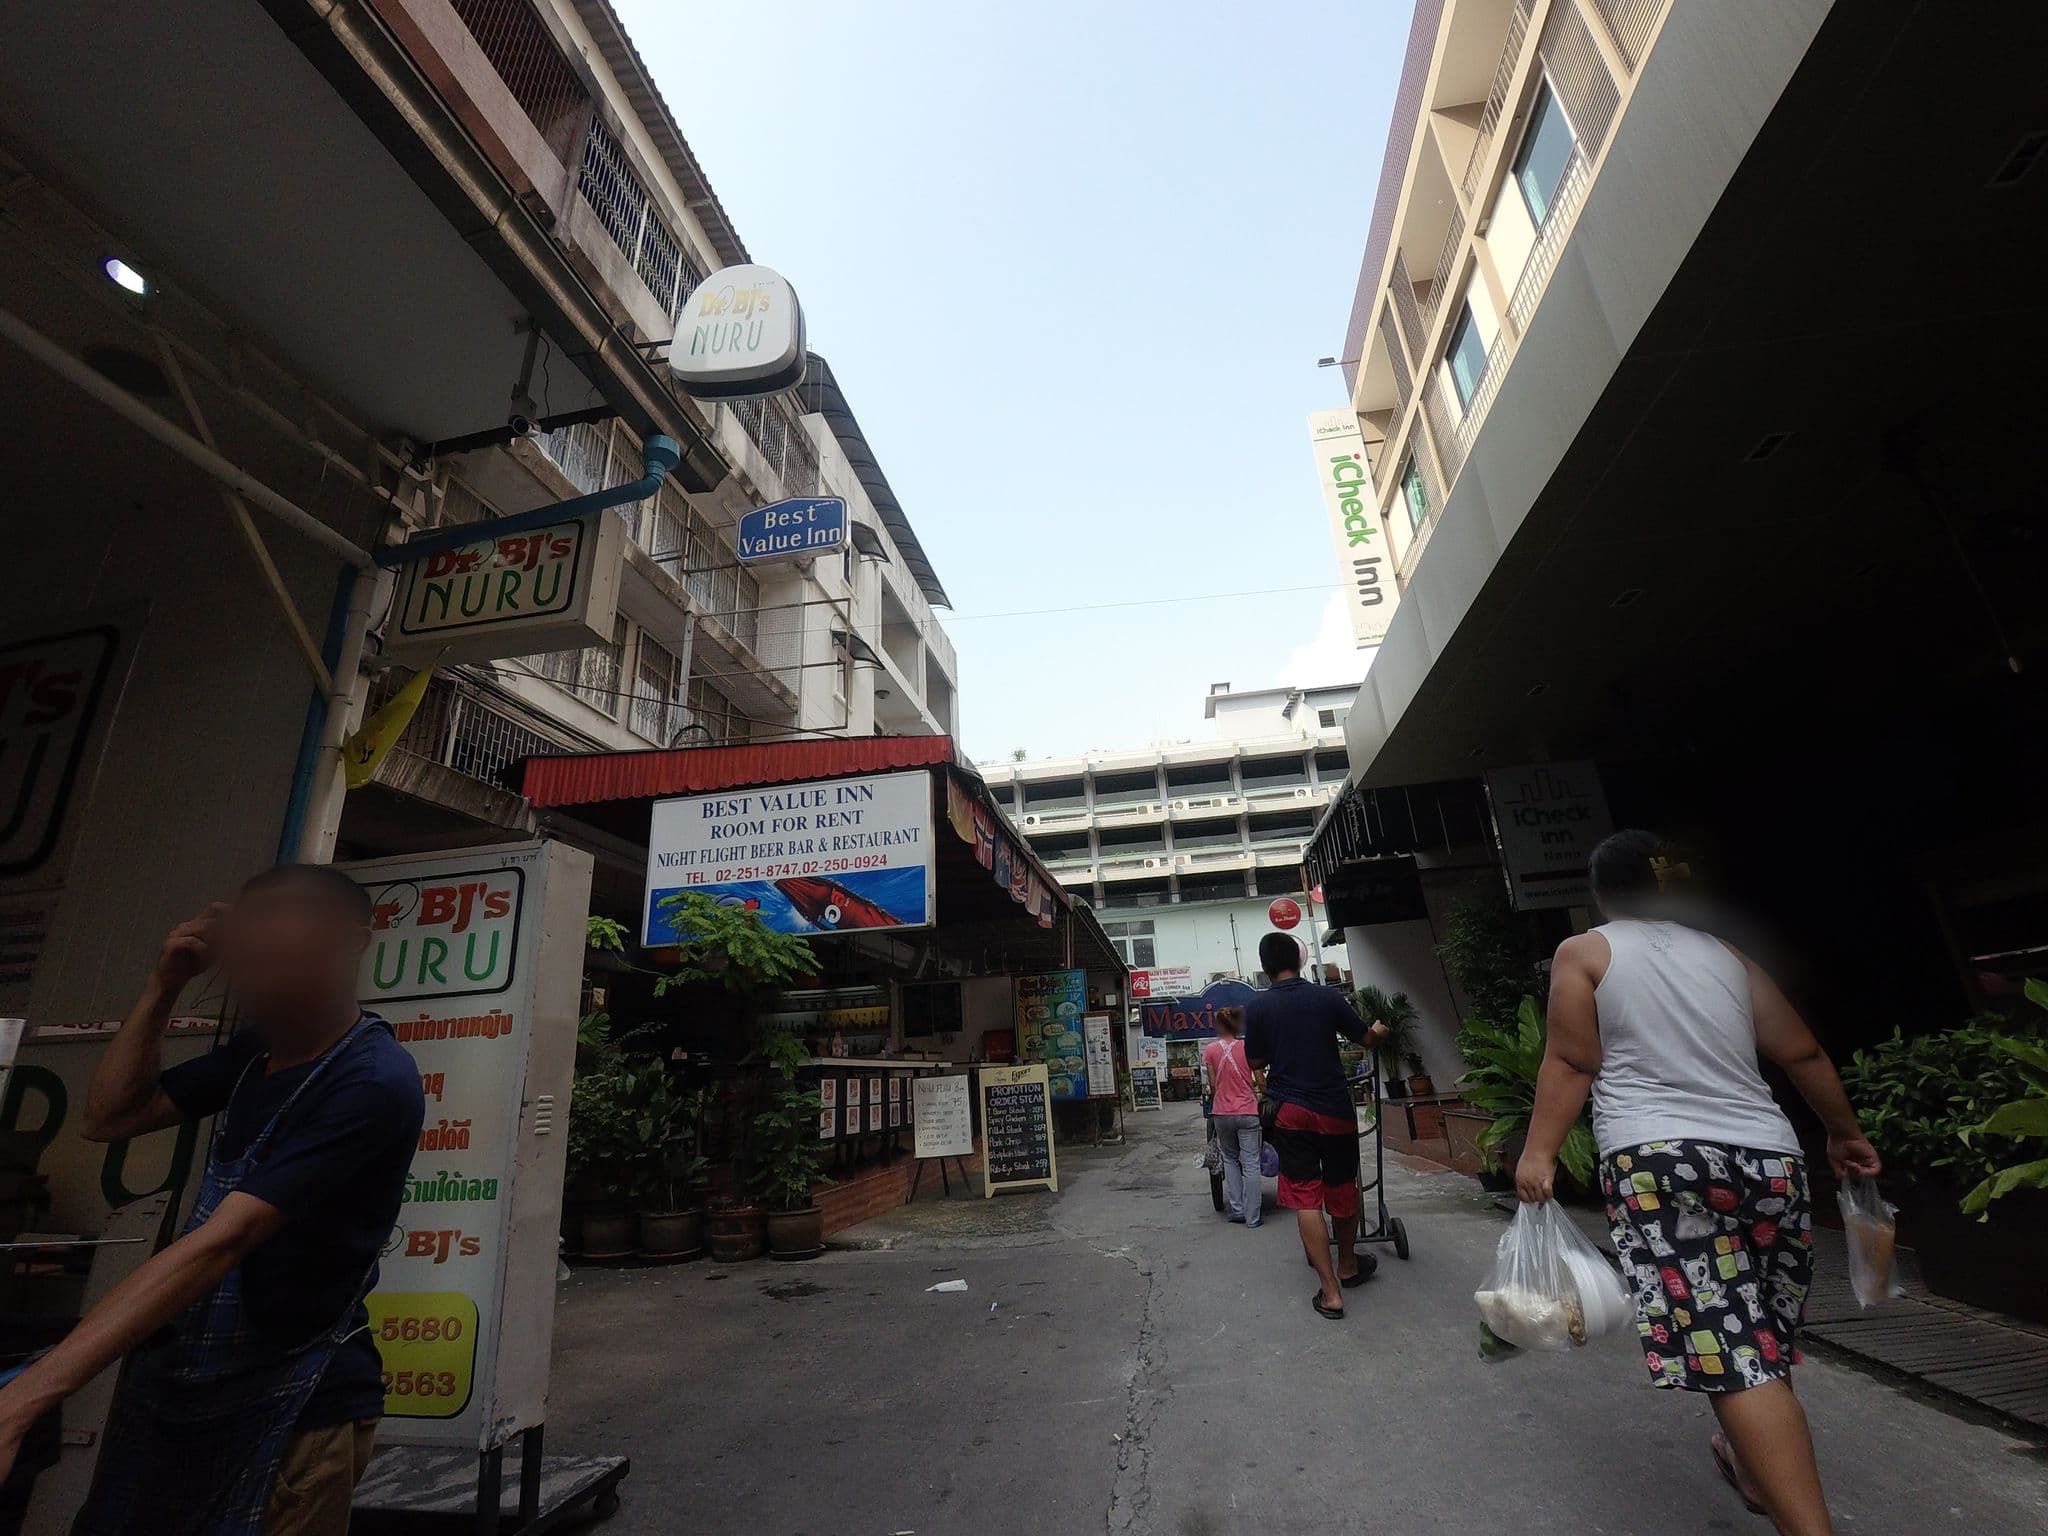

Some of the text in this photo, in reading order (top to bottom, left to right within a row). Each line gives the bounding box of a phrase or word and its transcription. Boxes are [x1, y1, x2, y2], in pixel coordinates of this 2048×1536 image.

[691, 320, 763, 355] NURU
[764, 505, 818, 529] Best
[1330, 453, 1377, 548] iCheck
[494, 532, 573, 572] BJ's
[742, 527, 841, 554] Value Inn
[419, 562, 563, 623] NURU
[1353, 557, 1384, 607] Inn
[702, 784, 874, 819] BEST VALUE INN
[1512, 804, 1591, 827] iCheck
[710, 809, 864, 840] ROOM FOR RENT
[657, 827, 920, 868] NIGHT FLIGHT BEER BAR & RESTAURANT
[686, 870, 710, 884] TEL.
[416, 882, 511, 934] BJ's
[373, 930, 500, 990] URU
[377, 1009, 513, 1042] พนักงานหญิง
[1147, 1001, 1216, 1032] Maxi
[990, 1093, 1044, 1107] ORDER STEAK
[991, 1084, 1041, 1097] PROMOTION
[404, 1230, 481, 1264] BJ's
